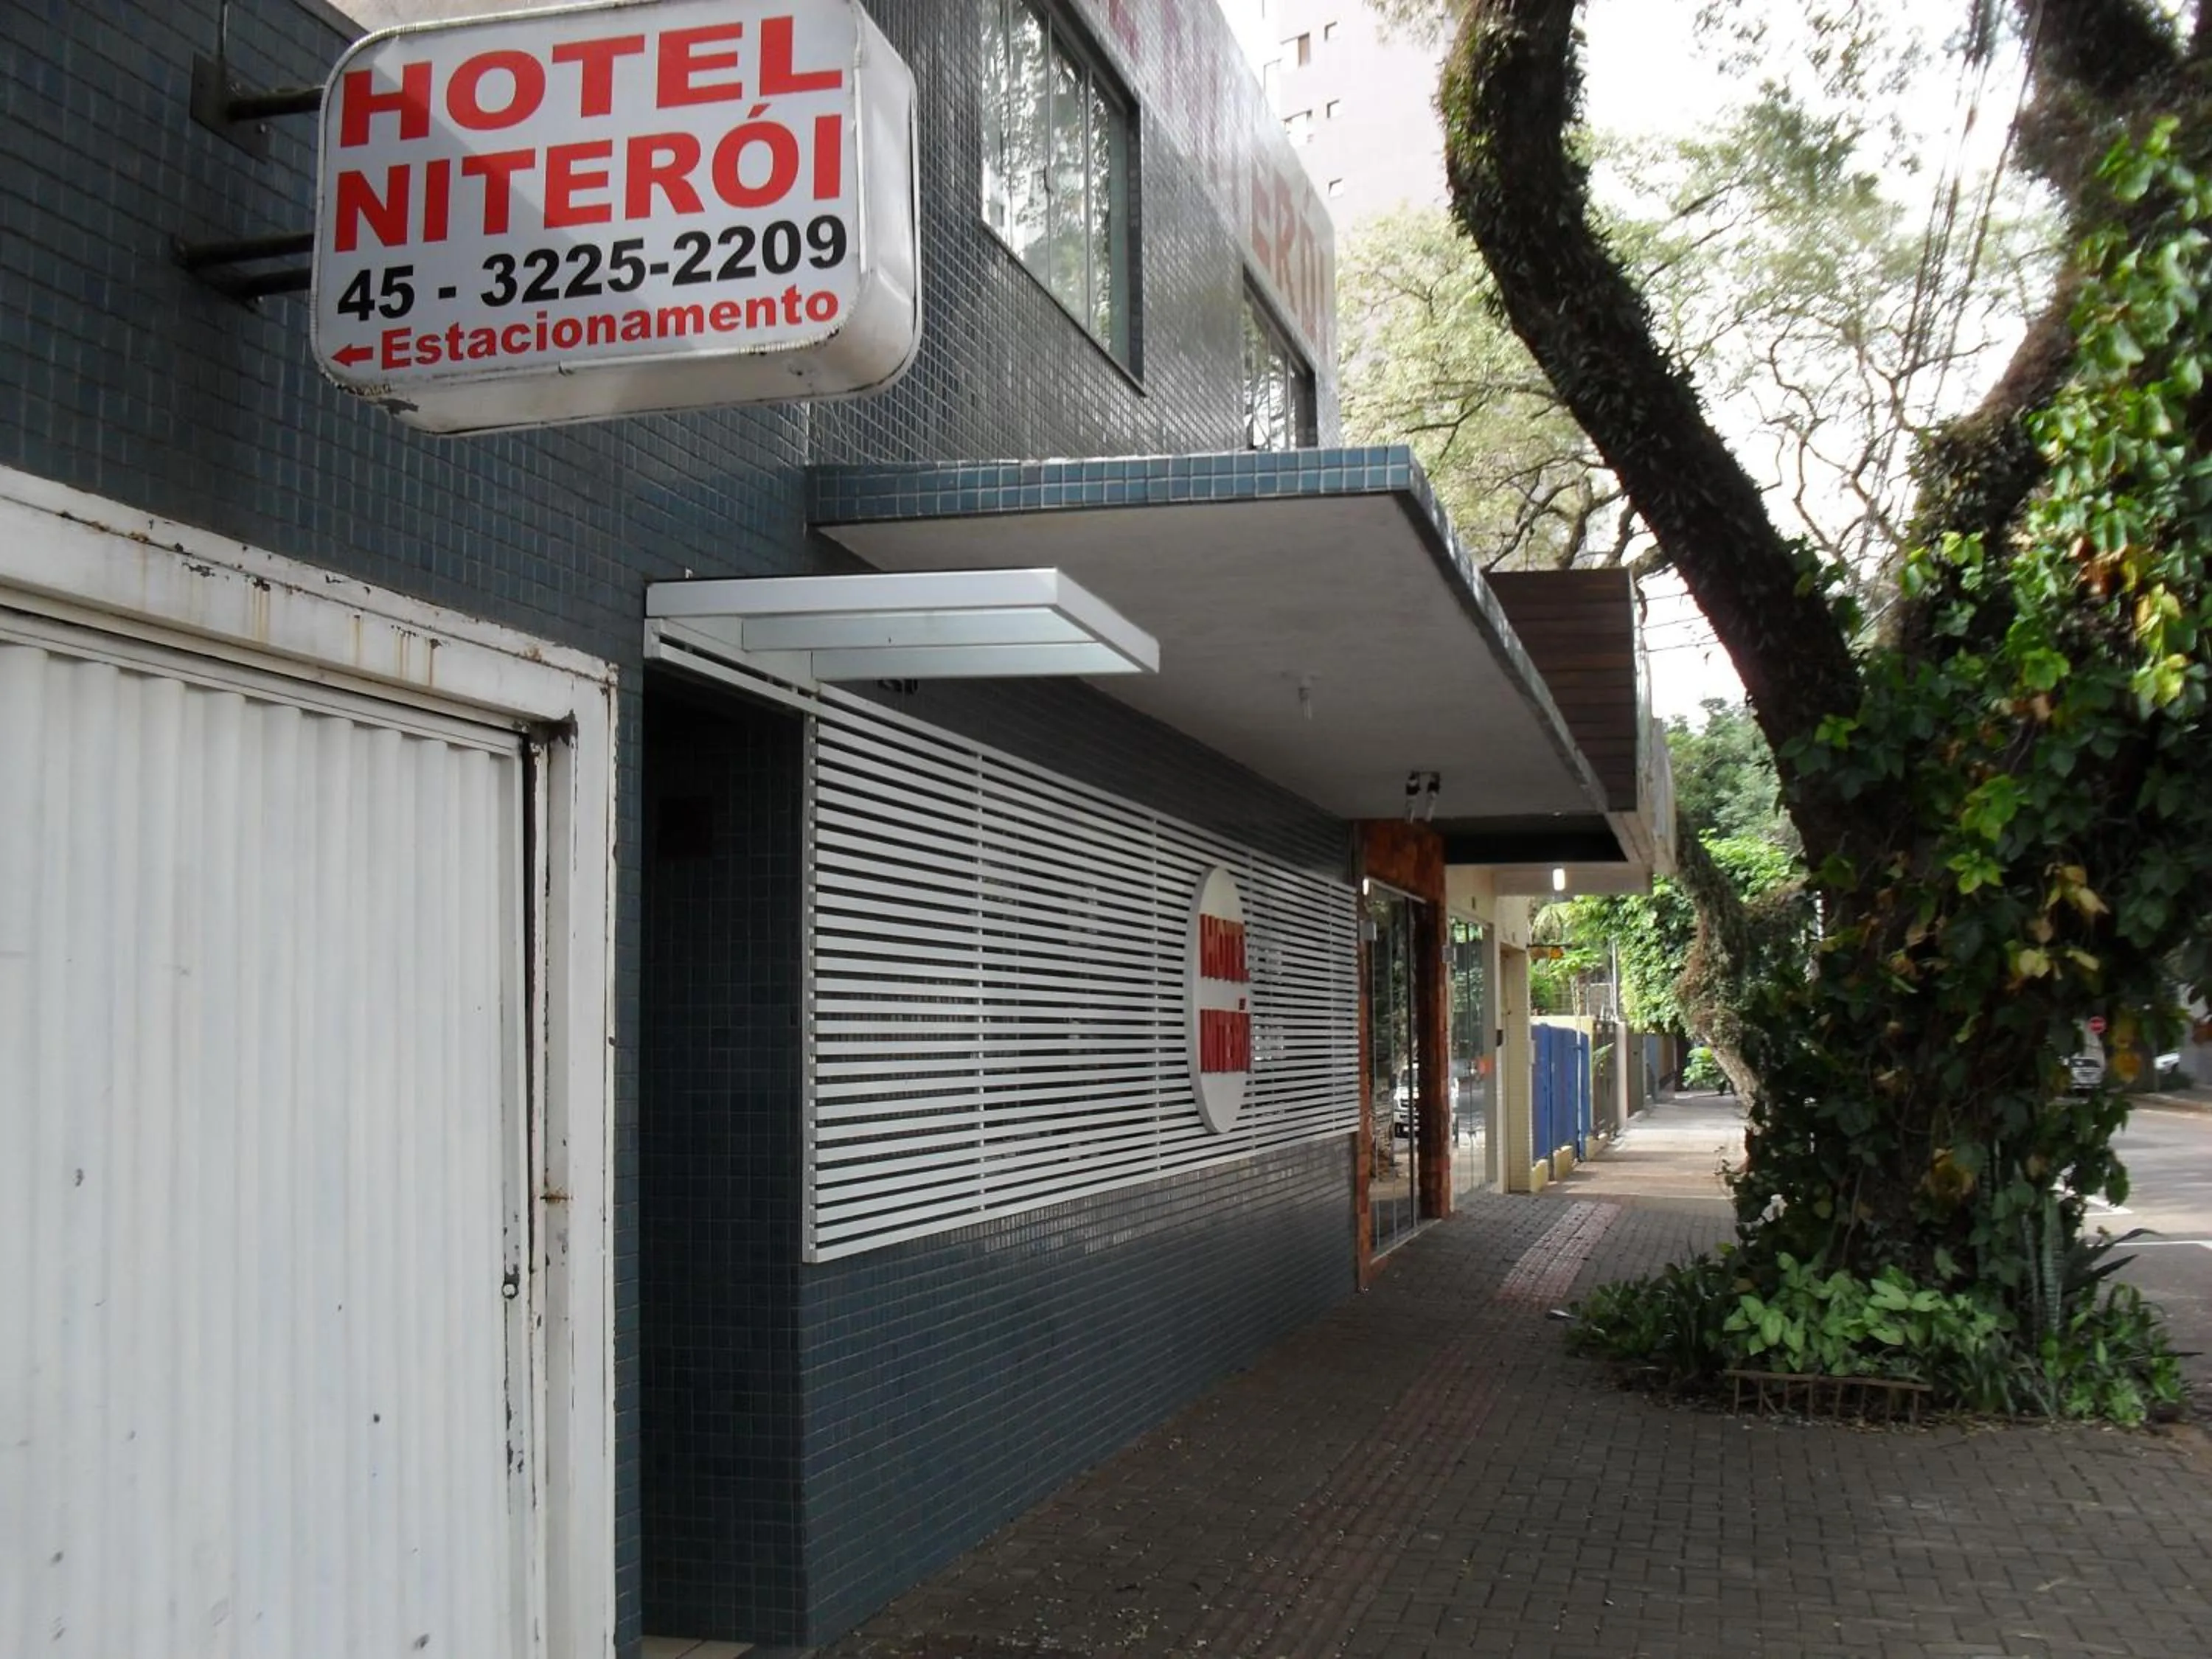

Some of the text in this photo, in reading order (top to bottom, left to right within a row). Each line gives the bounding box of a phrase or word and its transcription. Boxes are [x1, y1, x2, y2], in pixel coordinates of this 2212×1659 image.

[340, 16, 842, 147] HOTEL
[335, 104, 842, 252] NITERÓI
[337, 264, 415, 322] 45
[480, 215, 846, 307] 3225-2209
[380, 285, 839, 371] Estacionamento
[1200, 914, 1251, 982] HOTEL
